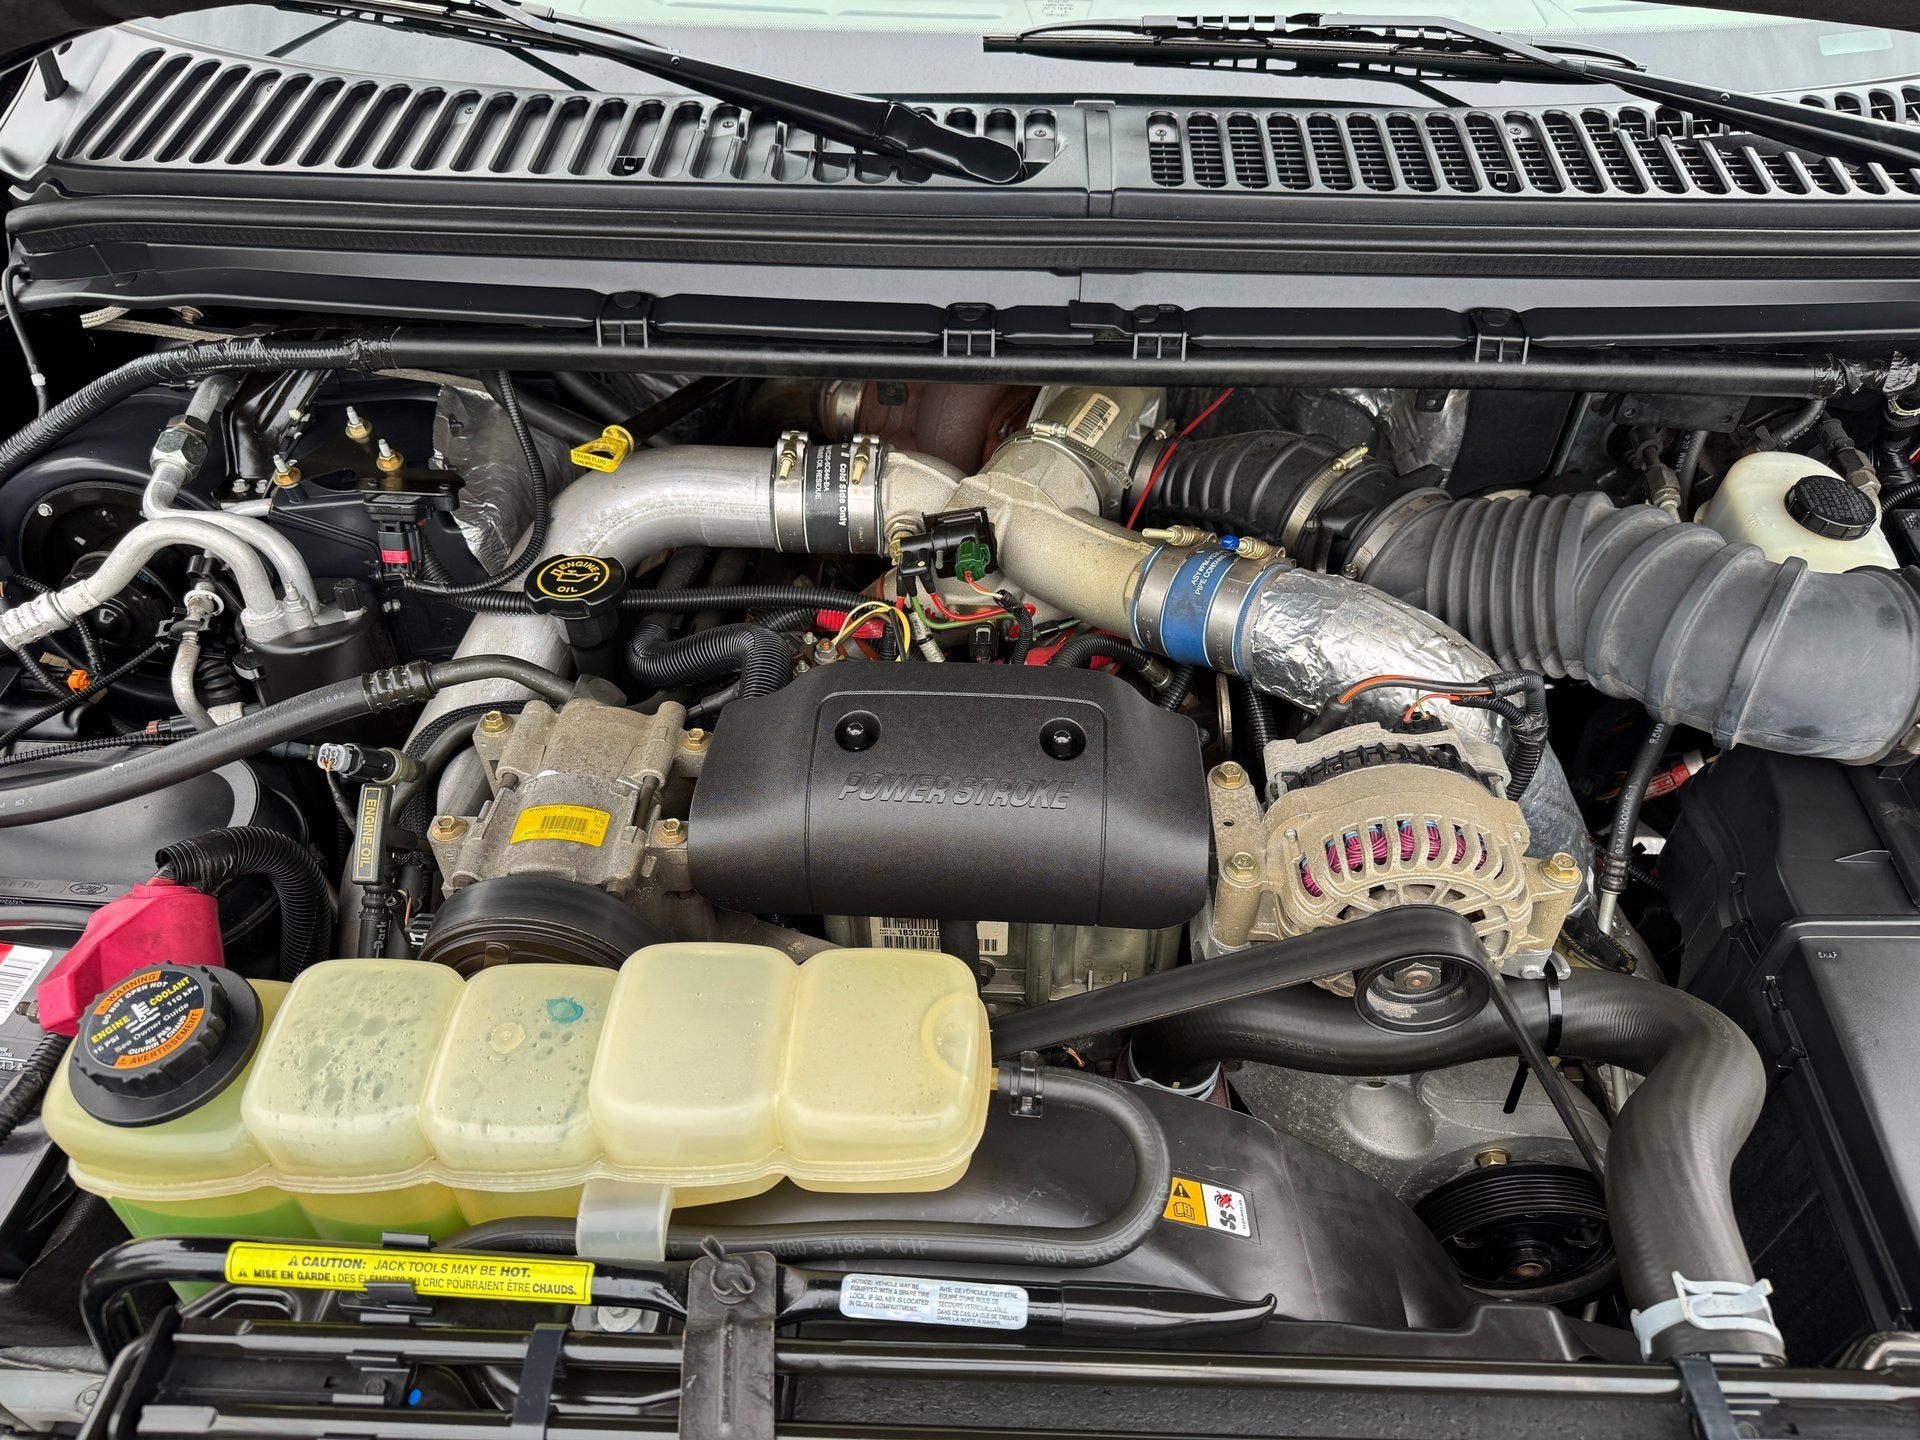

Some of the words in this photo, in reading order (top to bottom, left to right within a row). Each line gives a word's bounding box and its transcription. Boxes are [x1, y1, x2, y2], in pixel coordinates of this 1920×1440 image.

[840, 463, 848, 482] Cold
[815, 468, 823, 500] RESIDUE
[839, 483, 847, 504] Side
[839, 505, 847, 526] Only
[558, 561, 600, 573] ENGINE
[1195, 577, 1207, 596] PIPE
[838, 772, 951, 804] POWER
[953, 776, 1077, 809] STROKE
[362, 798, 377, 845] ENGINE
[360, 848, 372, 868] OIL
[107, 973, 156, 1001] WARNING
[90, 1015, 130, 1044] ENGINE
[149, 976, 190, 1006] COOLANT
[102, 1013, 111, 1025] DO
[109, 998, 124, 1014] NOT
[125, 984, 148, 998] OPEN
[104, 1035, 120, 1048] PSI
[166, 995, 182, 1007] 110
[184, 985, 199, 997] kPa
[114, 1039, 132, 1053] See
[133, 1021, 162, 1041] Owner
[163, 1002, 189, 1021] Guide
[128, 1041, 160, 1055] OUVRIR
[167, 1015, 187, 1038] CHAUD
[145, 1036, 158, 1045] NE
[157, 1026, 172, 1039] PAS
[129, 1012, 198, 1065] AVERTISSEMENT
[302, 1256, 366, 1269] CAUTION:
[374, 1260, 408, 1272] JACK
[408, 1261, 449, 1274] TOOLS
[451, 1264, 477, 1275] MAY
[480, 1266, 496, 1276] BE
[500, 1267, 531, 1278] HOT.
[254, 1269, 278, 1279] MISE
[280, 1270, 294, 1280] EN
[338, 1273, 356, 1283] DES
[423, 1278, 445, 1288] CRIC
[446, 1279, 504, 1291] POURRAIENT
[532, 1283, 577, 1295] CHAUDS.
[850, 1285, 878, 1293] EQUIPPED
[898, 1289, 917, 1297] SPARE
[876, 1280, 898, 1288] VEHICLE
[855, 1300, 874, 1309] GLOVE
[903, 1298, 930, 1306] LOCATED
[938, 1300, 963, 1309] SECOURS
[976, 1296, 991, 1304] ROUE
[989, 1290, 1004, 1298] PEUT
